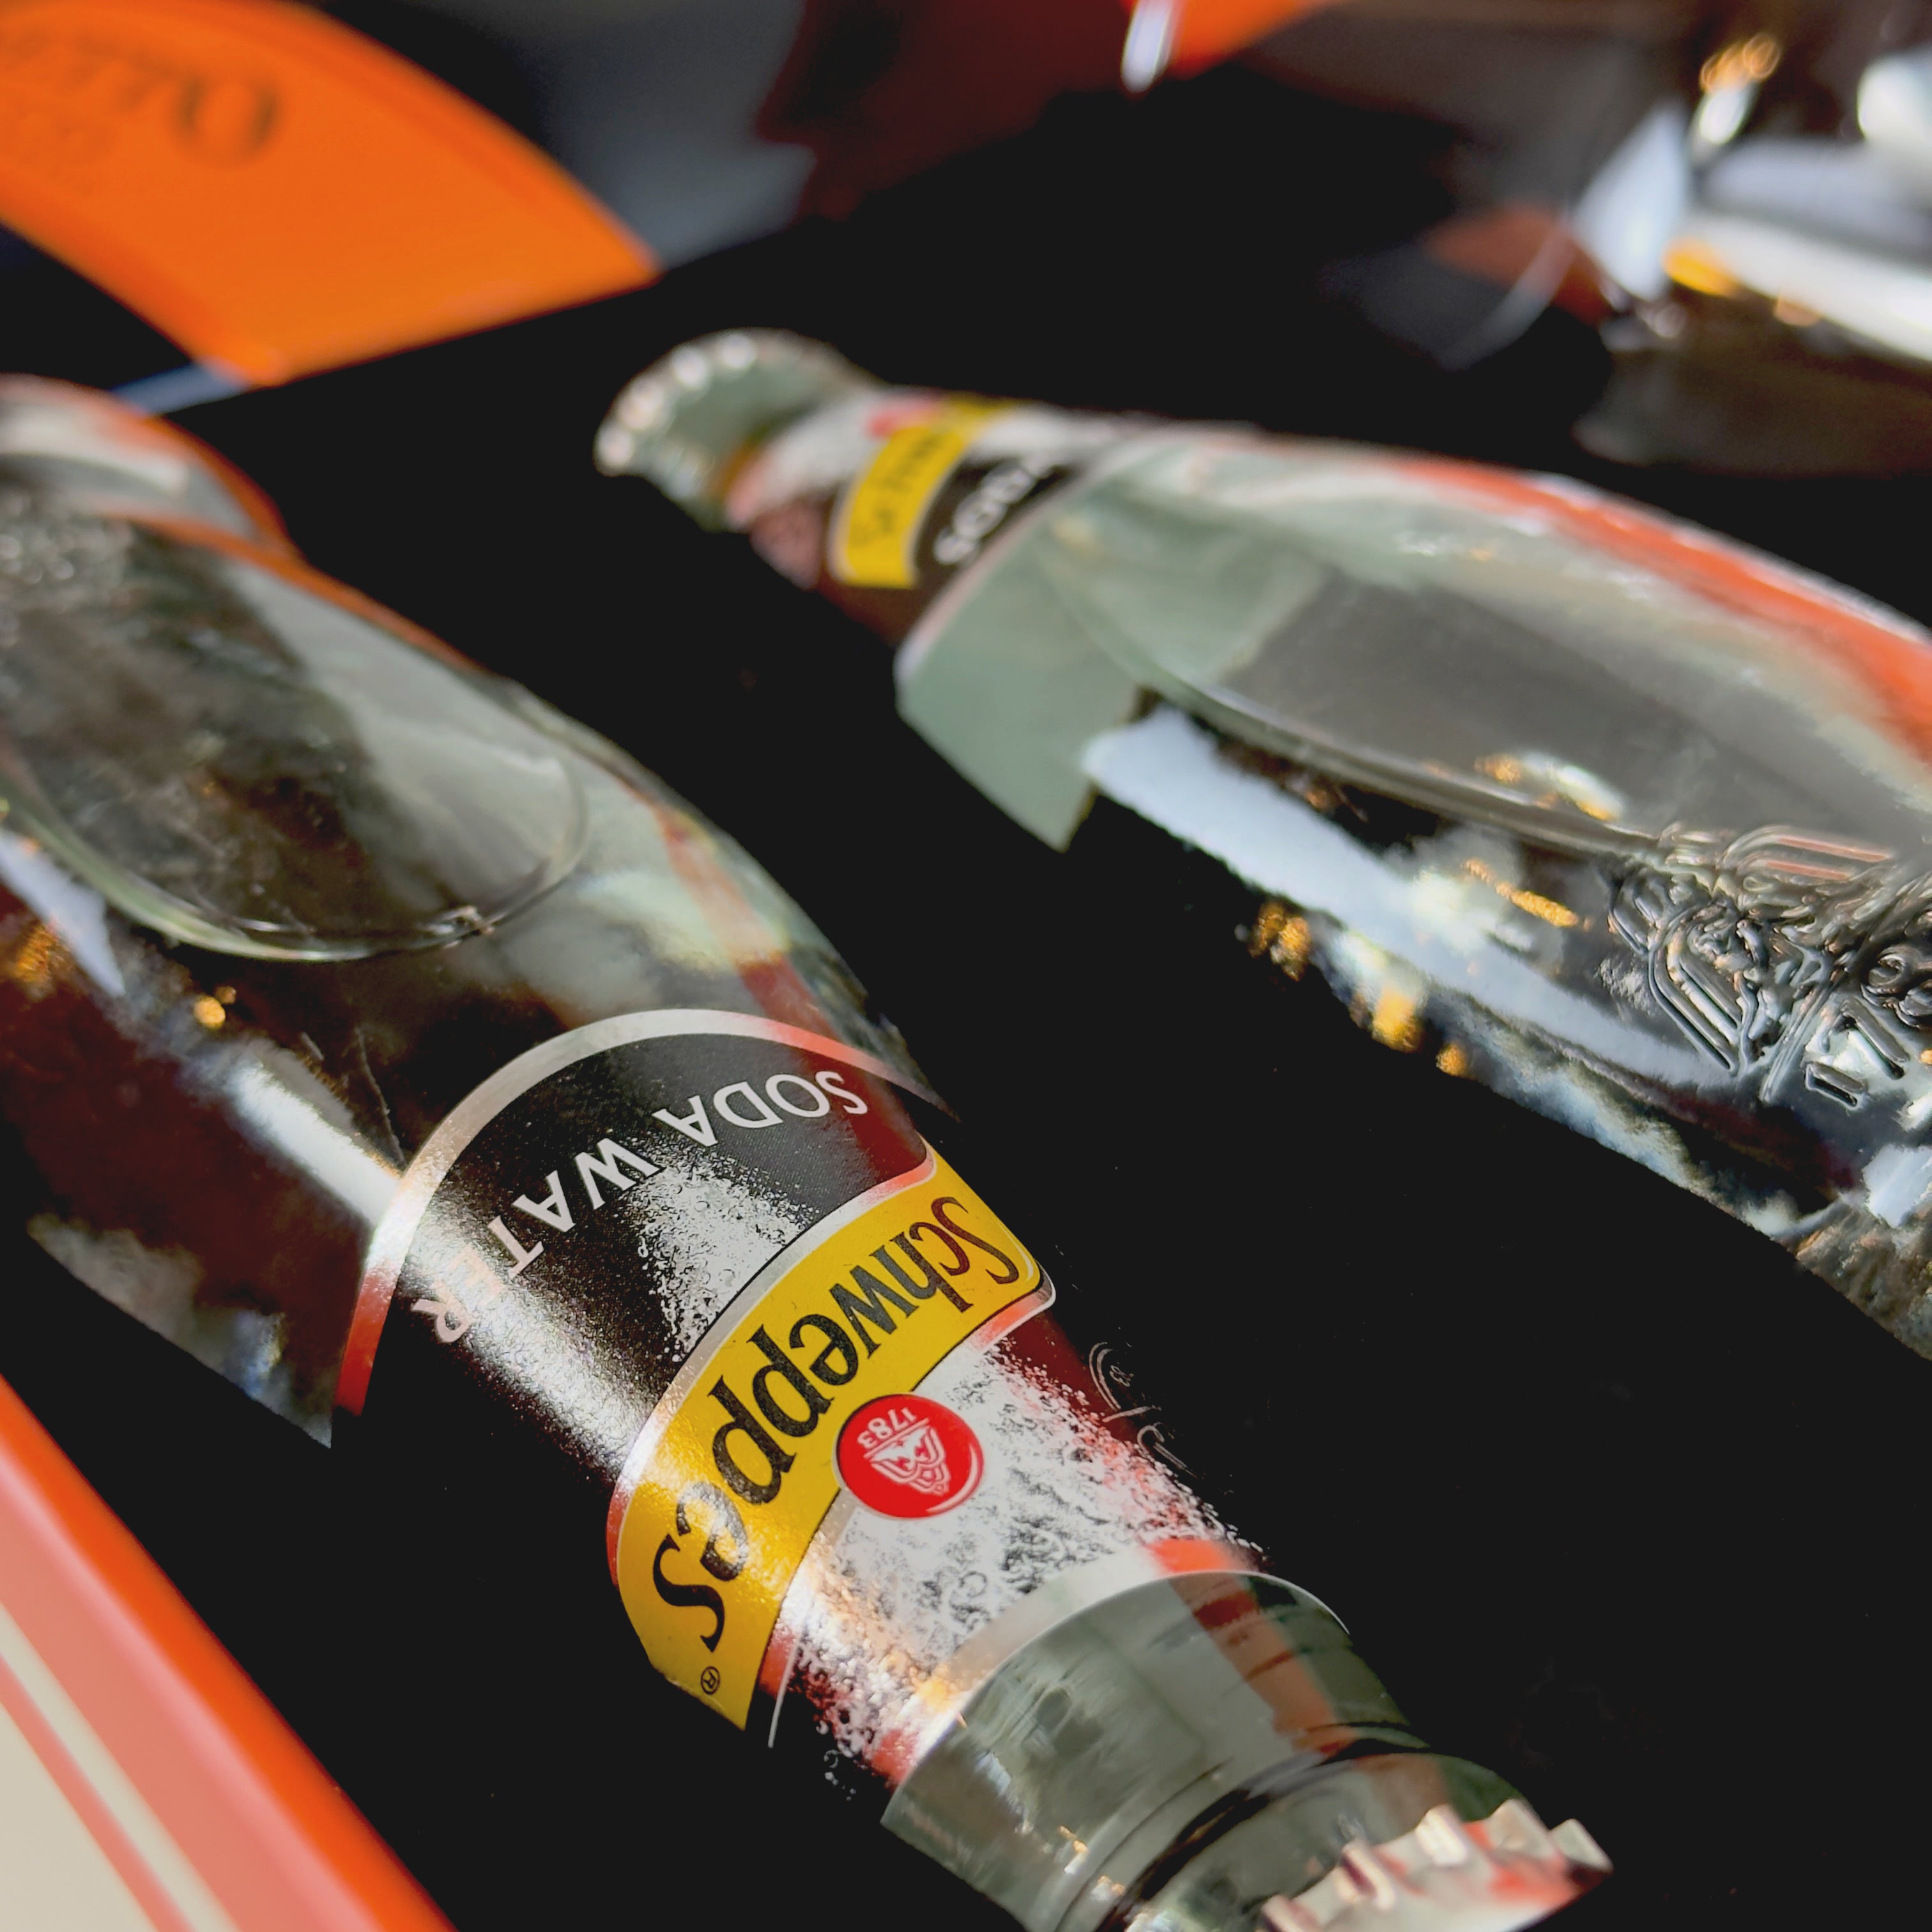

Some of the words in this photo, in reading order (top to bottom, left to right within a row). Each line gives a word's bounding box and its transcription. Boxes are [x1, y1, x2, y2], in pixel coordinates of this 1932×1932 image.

[651, 1070, 868, 1147] SODA
[410, 1137, 666, 1343] WATER
[652, 1196, 1020, 1653] Schweppes
[856, 1407, 917, 1449] 1783
